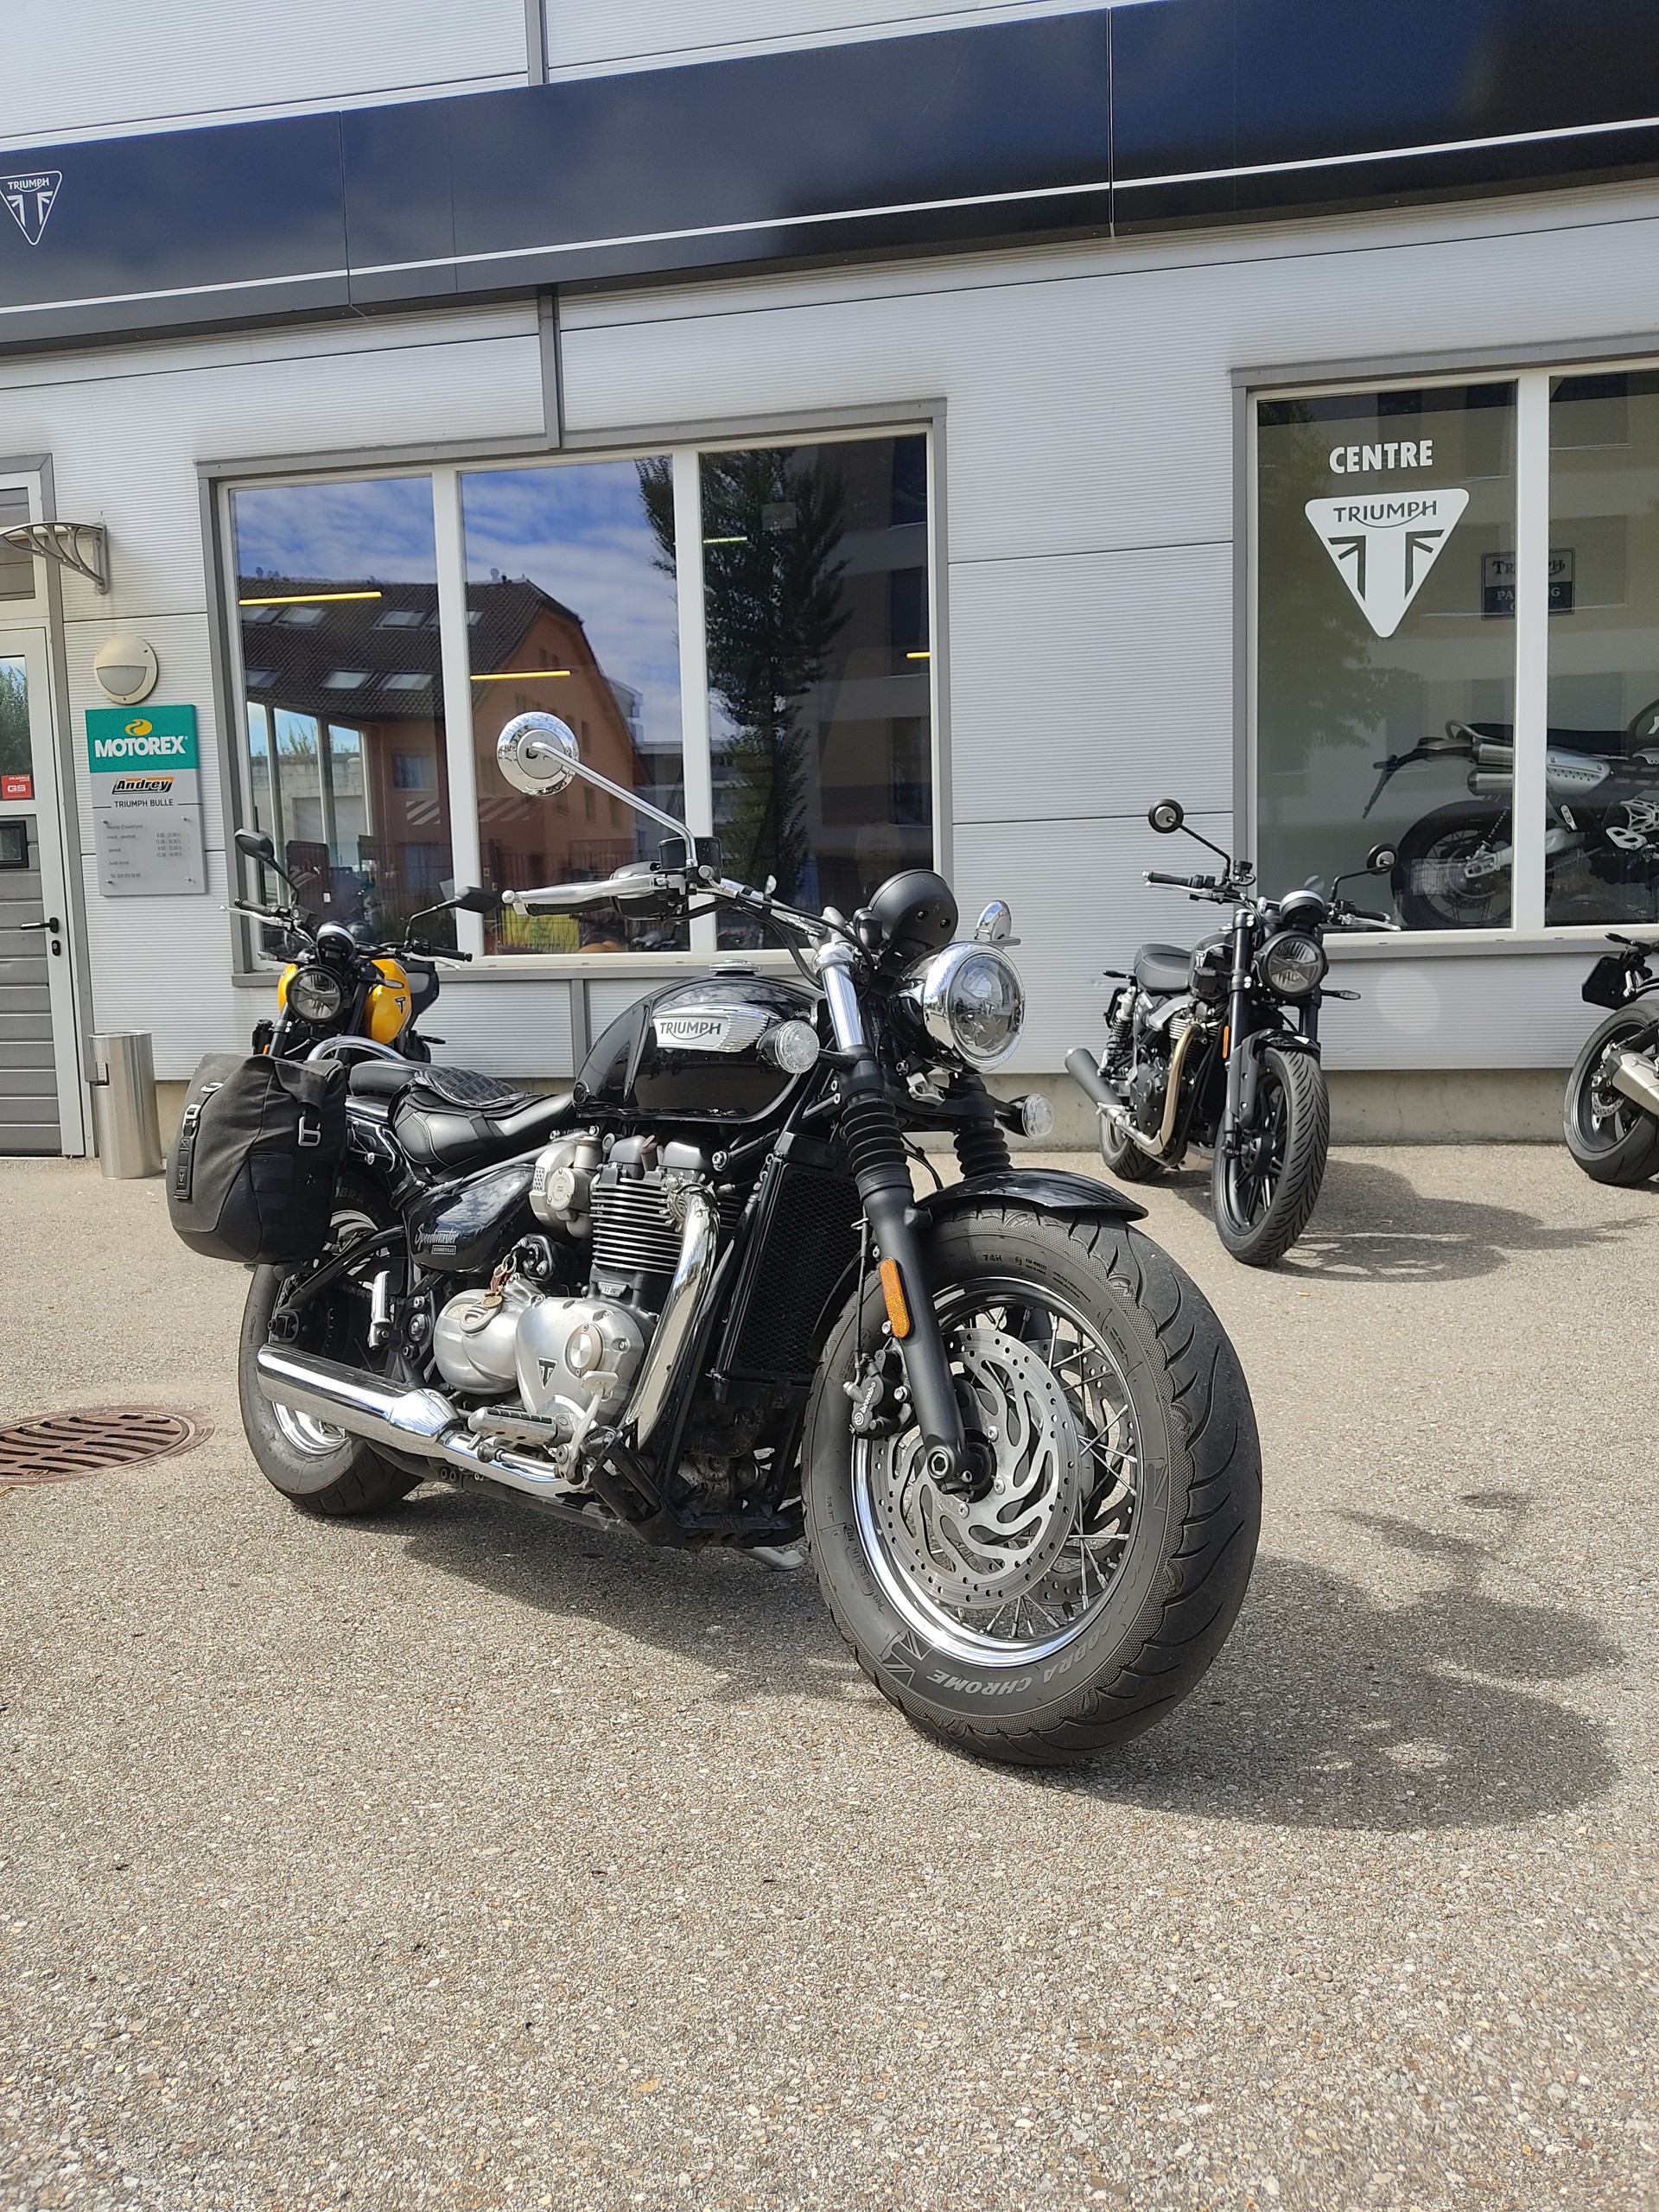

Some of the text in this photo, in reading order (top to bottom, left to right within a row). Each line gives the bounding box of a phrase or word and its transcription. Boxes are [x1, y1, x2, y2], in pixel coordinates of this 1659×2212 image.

[7, 177, 50, 193] TRIUMPH
[1329, 439, 1433, 474] CENTRE
[1332, 499, 1437, 528] TRIUMPH
[94, 734, 187, 758] MOTOREX
[115, 779, 170, 792] Andrey
[113, 798, 174, 809] TRIUMPH BULLE
[659, 1021, 722, 1040] TRIUMPH
[415, 1223, 460, 1252] Speedmaster
[859, 1381, 876, 1414] brembo
[925, 1617, 1112, 1695] COBRA CHROME
